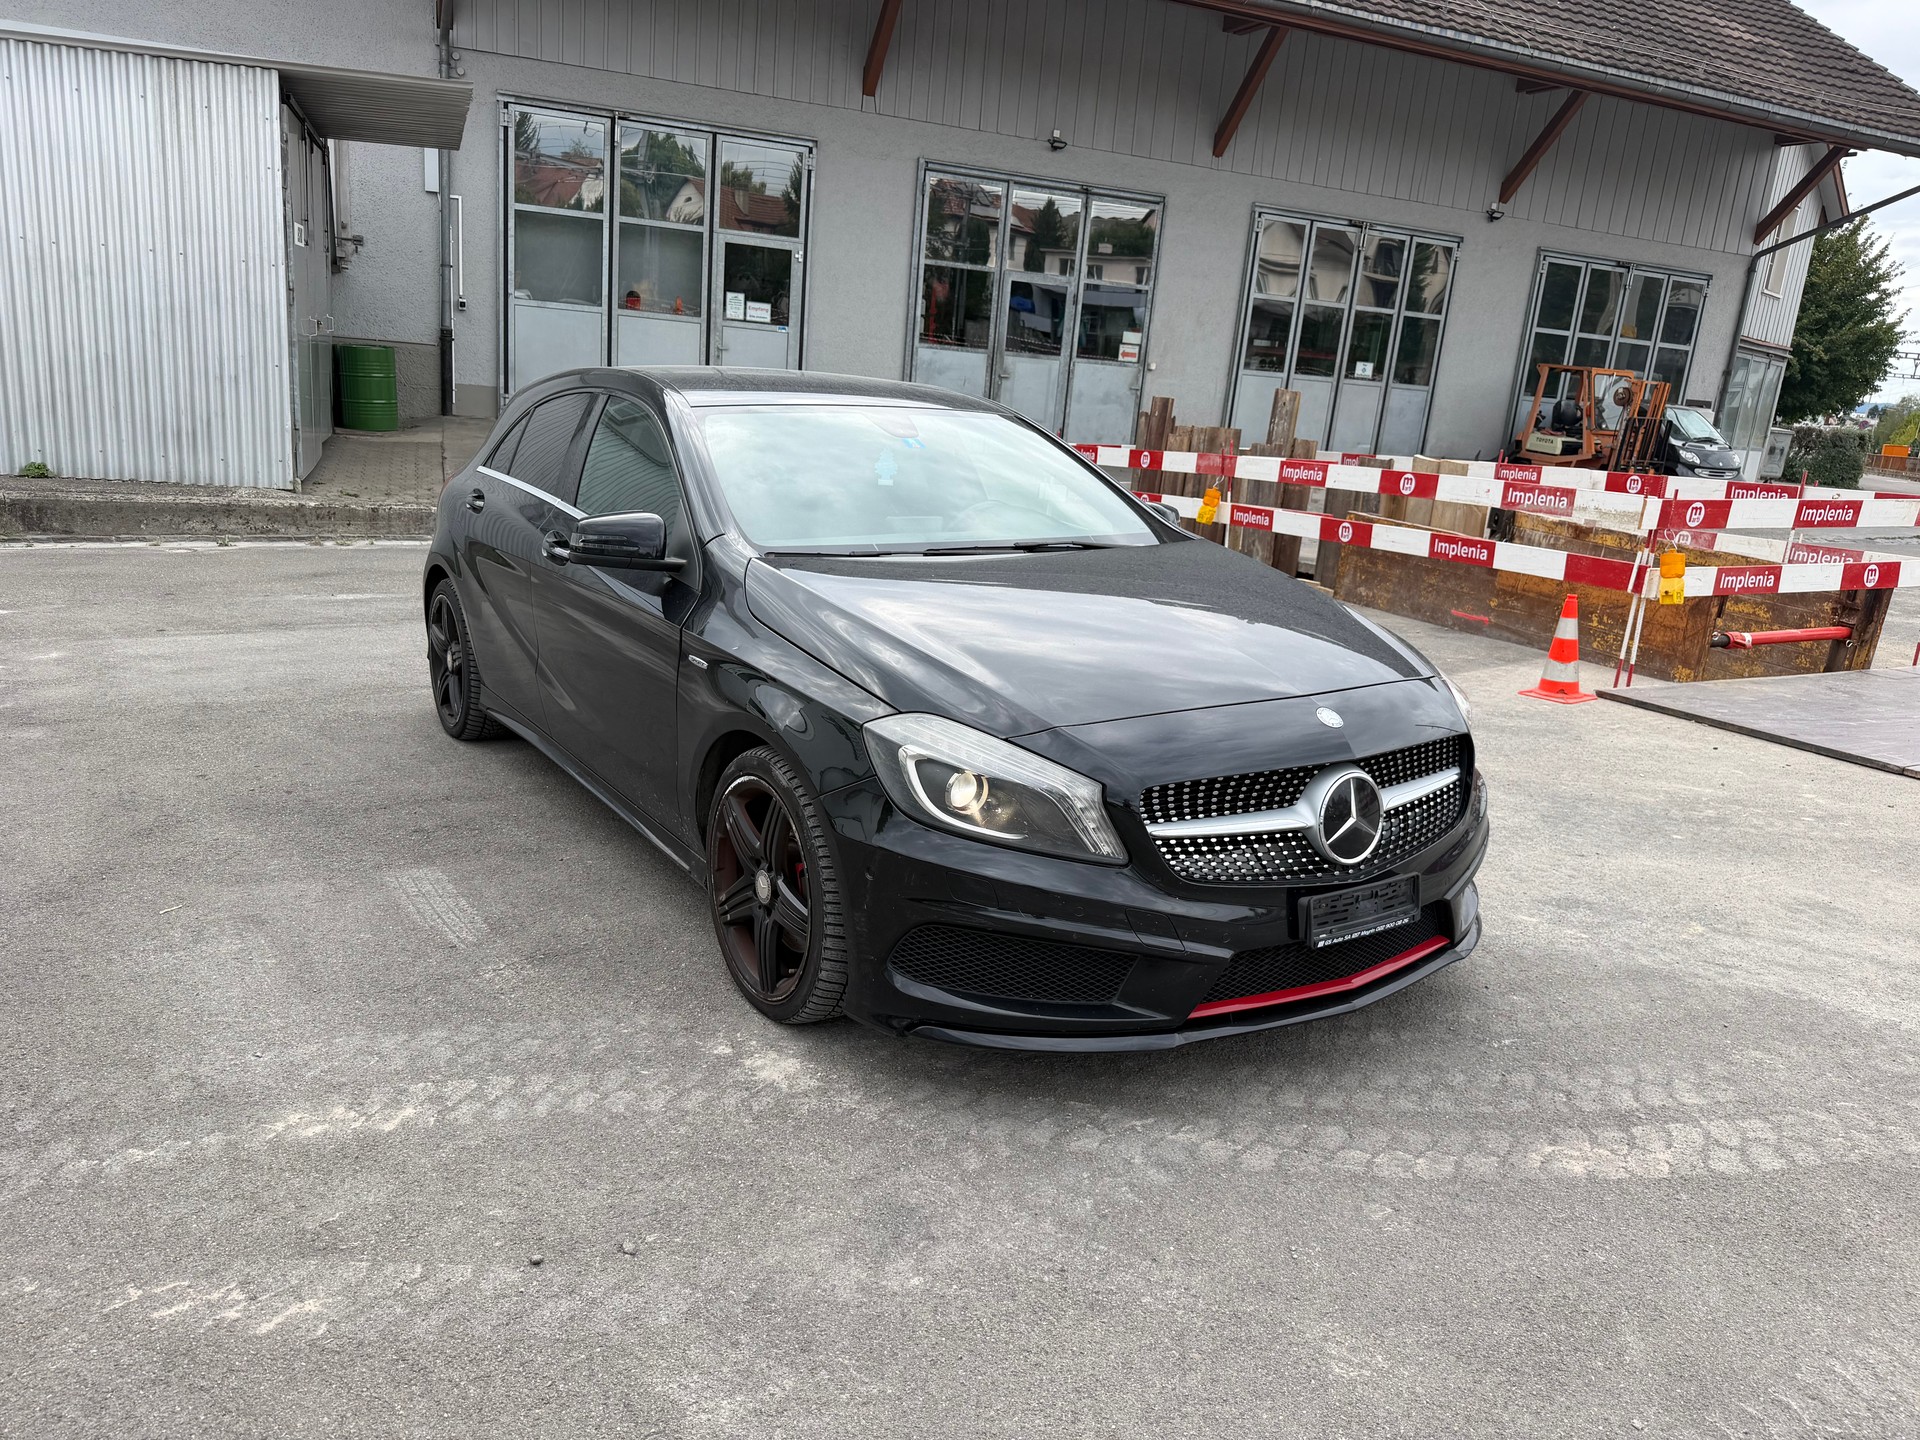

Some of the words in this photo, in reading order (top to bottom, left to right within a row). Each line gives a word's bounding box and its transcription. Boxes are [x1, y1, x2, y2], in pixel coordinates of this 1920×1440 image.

[1282, 465, 1323, 481] Implenia
[1507, 487, 1568, 508] Implenia
[1233, 509, 1270, 526] Implenia
[1800, 505, 1853, 525] Implenia
[1434, 538, 1488, 560] Implenia
[1719, 570, 1775, 592] Implenia
